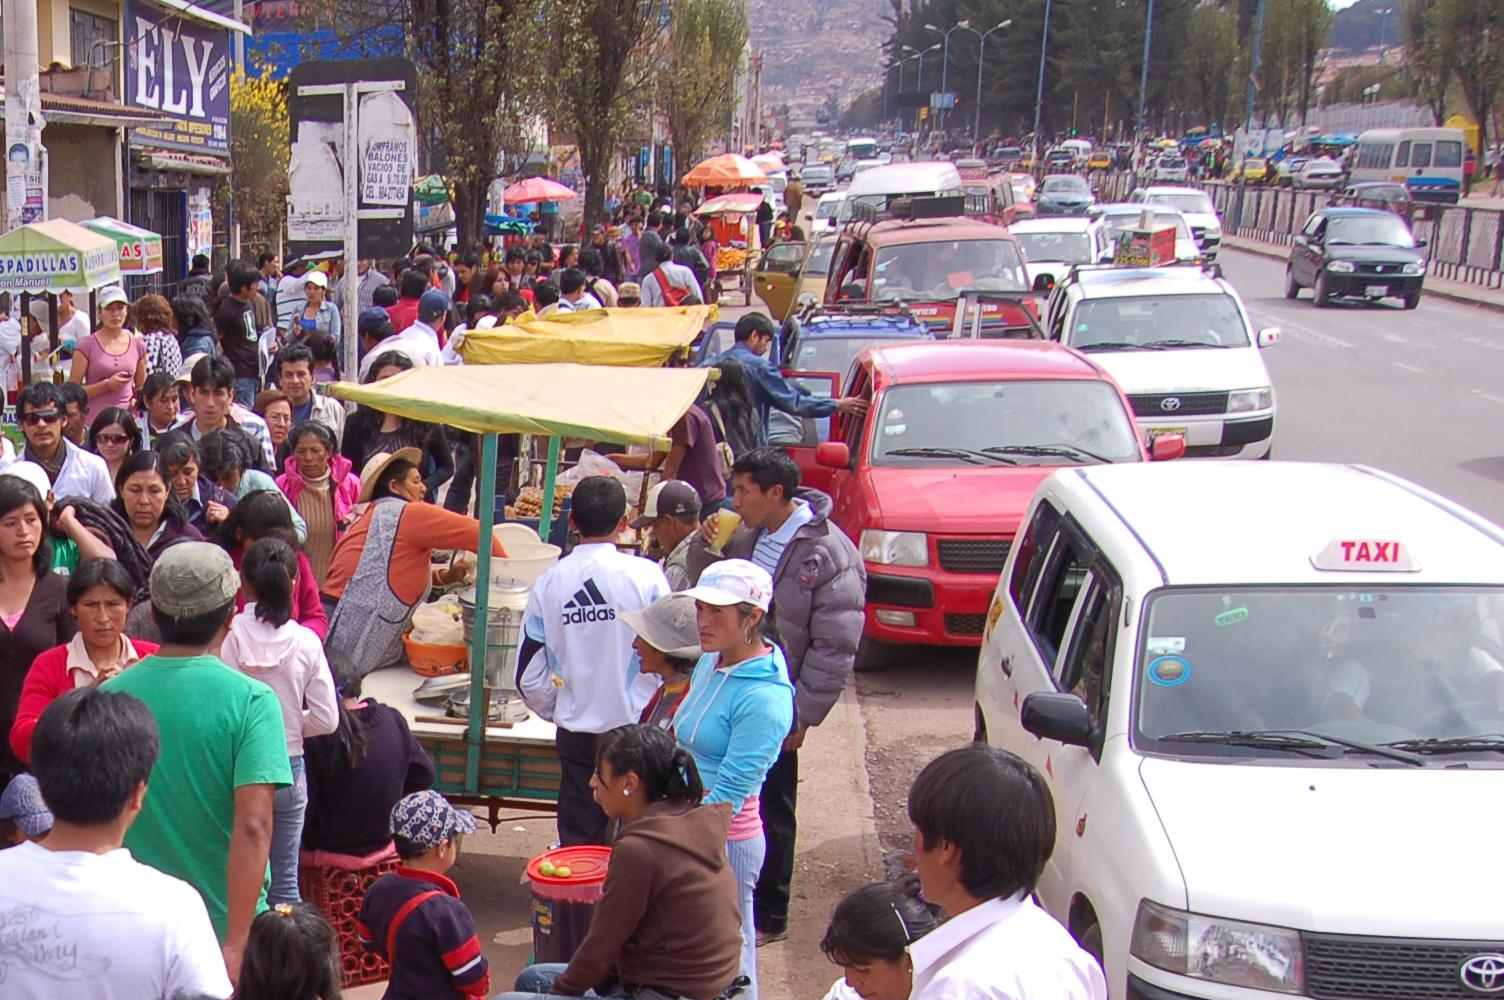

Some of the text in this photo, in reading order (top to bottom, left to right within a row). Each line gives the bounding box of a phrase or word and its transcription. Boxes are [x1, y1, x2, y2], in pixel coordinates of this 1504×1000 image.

[136, 16, 214, 118] ELY
[367, 152, 408, 163] BALONES
[367, 163, 406, 173] VACIOS DE
[15, 277, 49, 287] Manuel
[1341, 541, 1400, 562] TAXI
[562, 607, 616, 625] adidas
